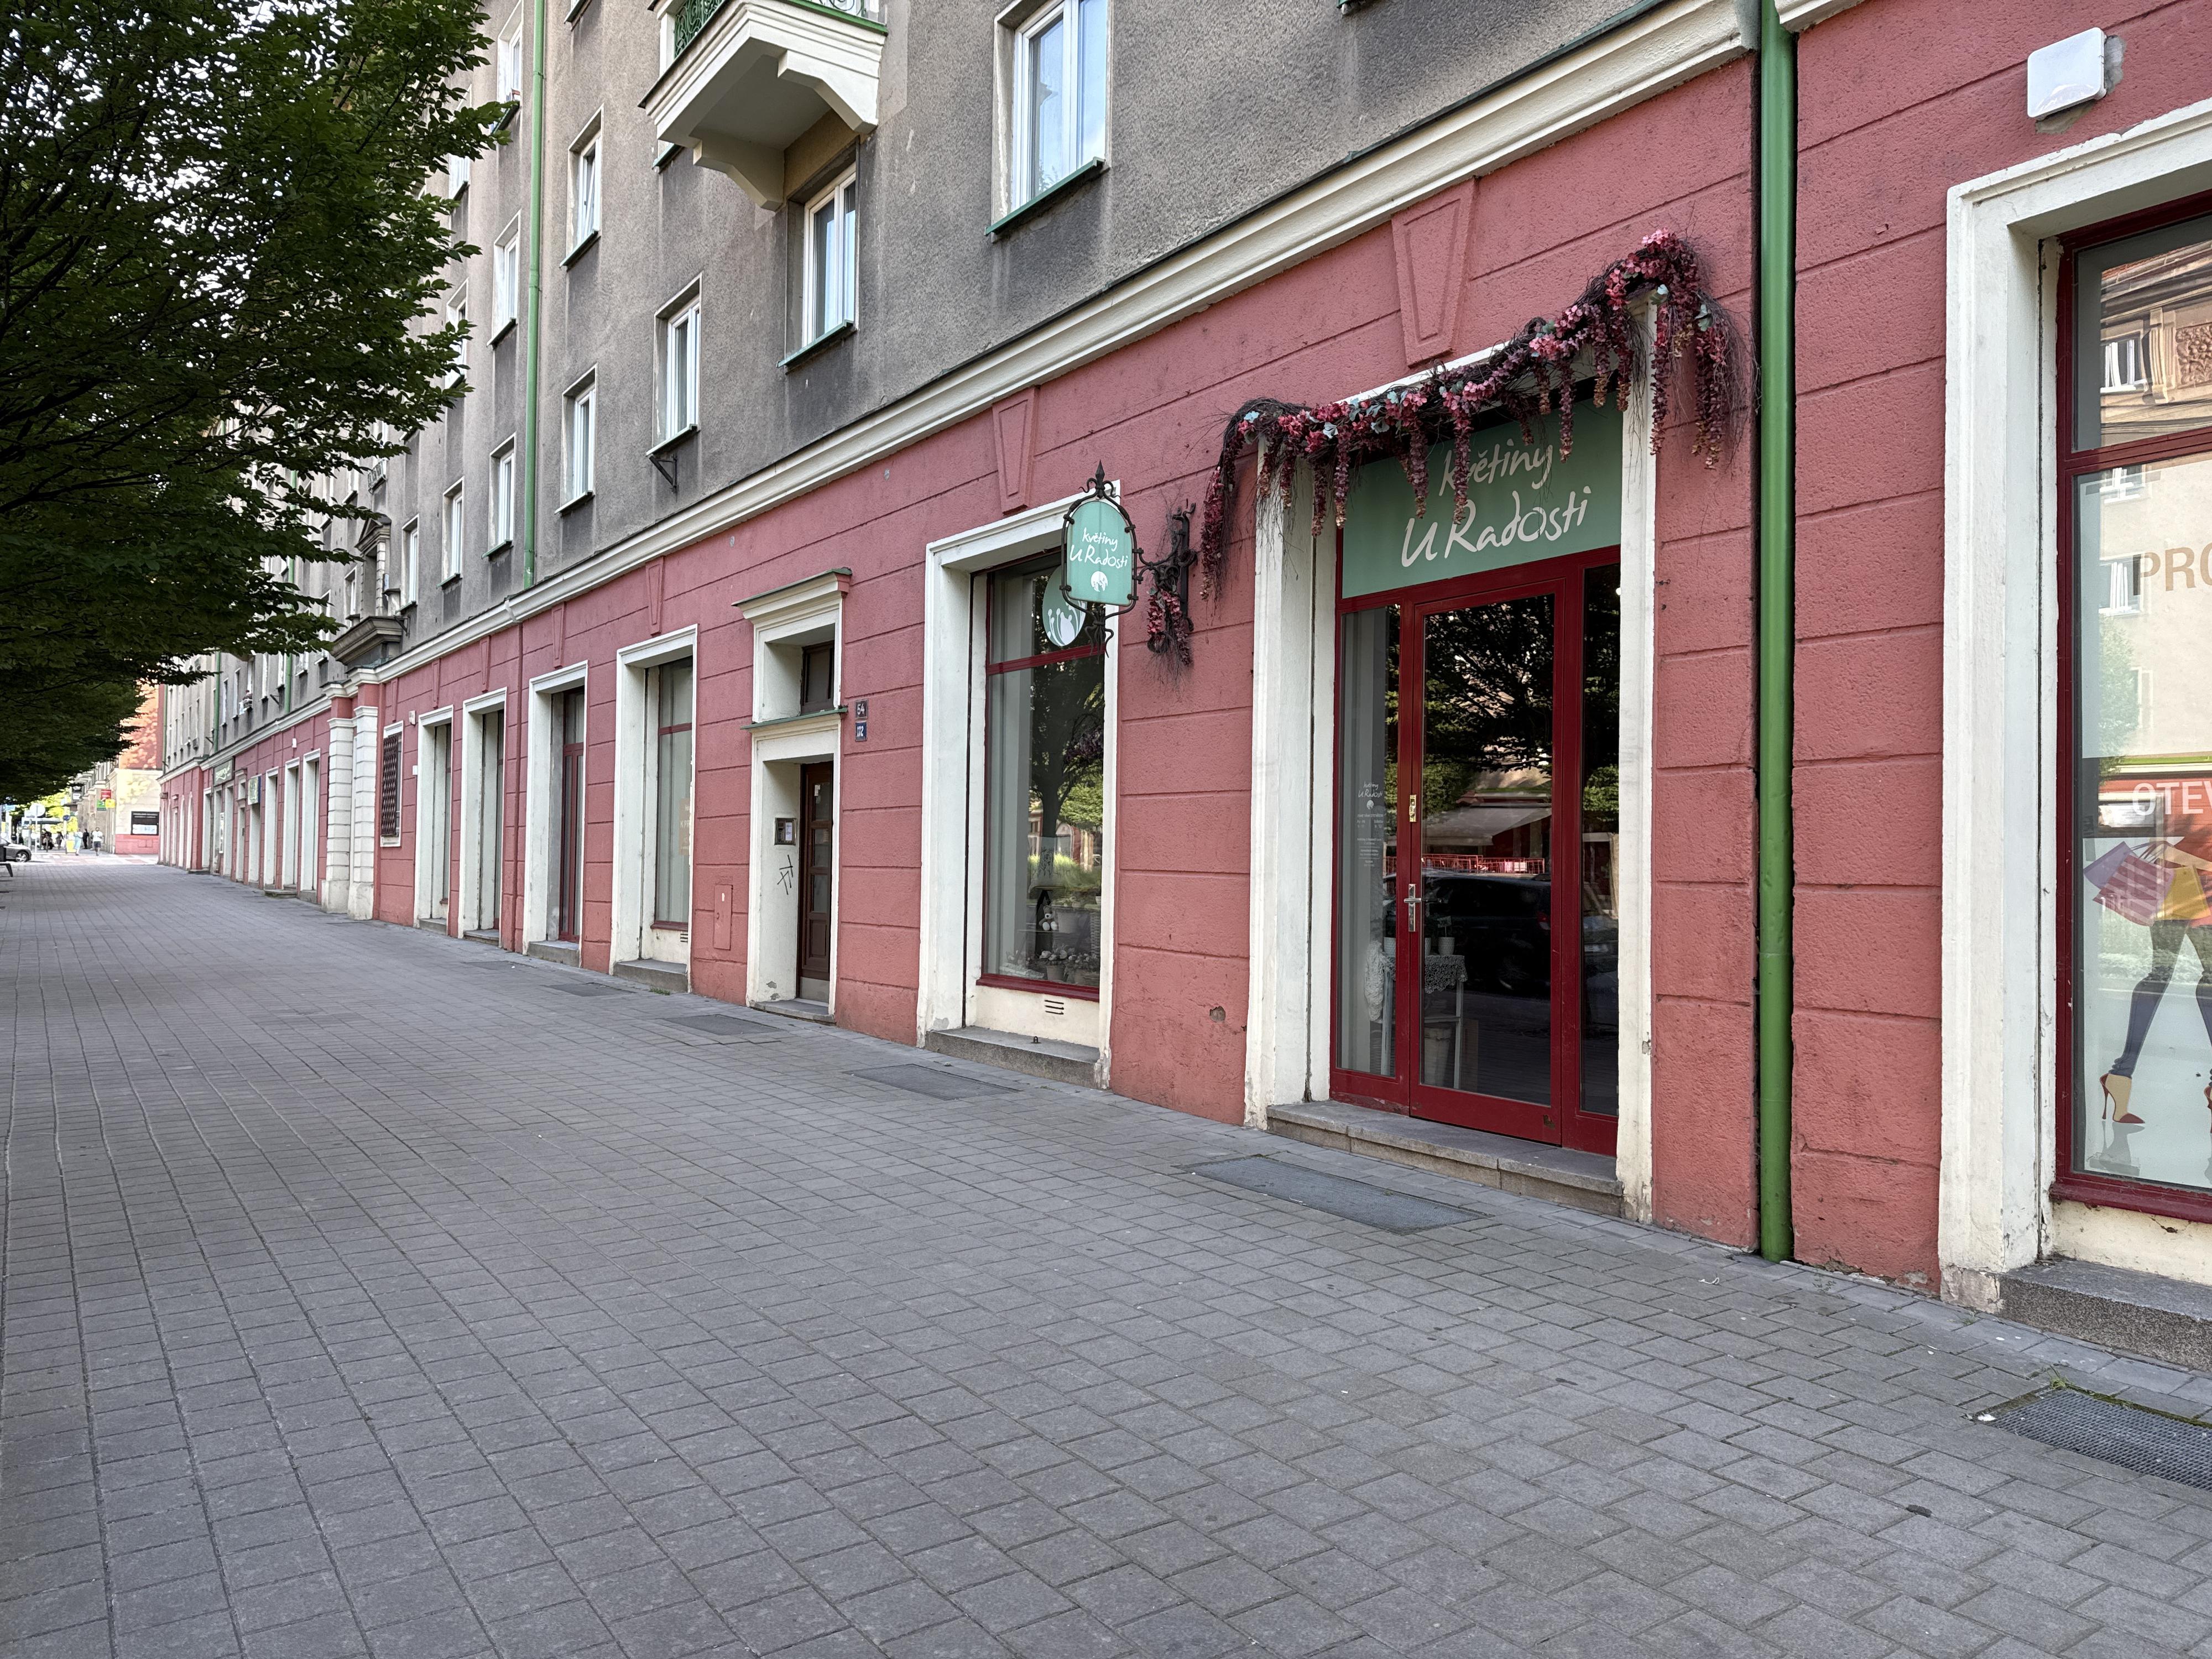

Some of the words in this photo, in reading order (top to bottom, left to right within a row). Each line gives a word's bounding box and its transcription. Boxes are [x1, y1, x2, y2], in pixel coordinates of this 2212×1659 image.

[1401, 518, 1438, 567] U
[1444, 486, 1592, 559] Radosti
[1082, 527, 1118, 551] květiny
[1070, 544, 1083, 561] U
[1084, 544, 1128, 568] Radosti
[857, 703, 865, 716] 54
